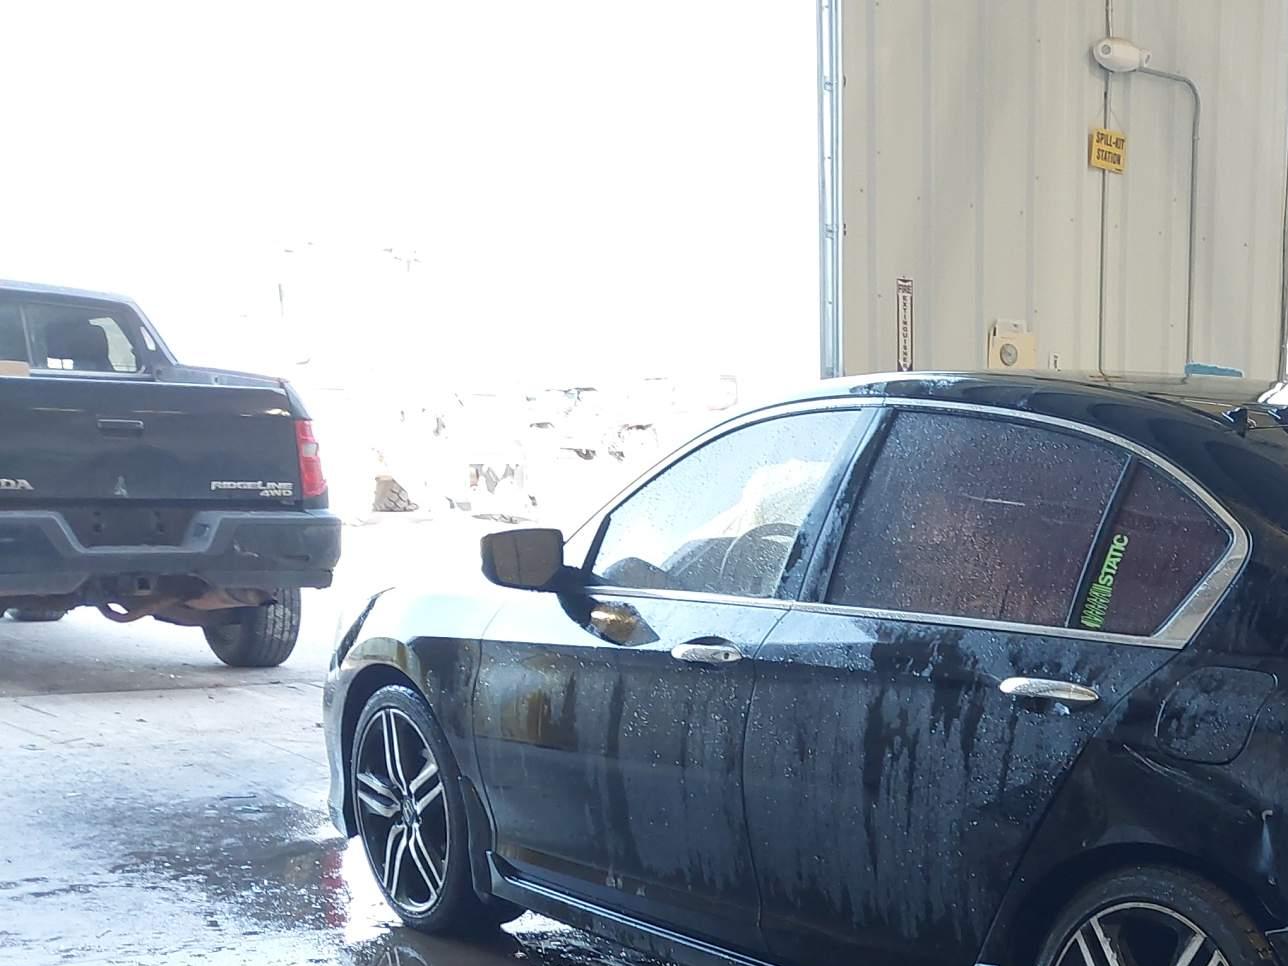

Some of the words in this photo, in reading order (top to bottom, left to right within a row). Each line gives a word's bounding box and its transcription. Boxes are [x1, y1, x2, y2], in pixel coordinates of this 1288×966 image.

[1095, 131, 1125, 150] SPILL-KIT
[1096, 148, 1121, 165] STATION
[210, 481, 293, 491] RIDGELINE
[259, 489, 293, 497] 4WD
[1098, 533, 1129, 587] STATIC
